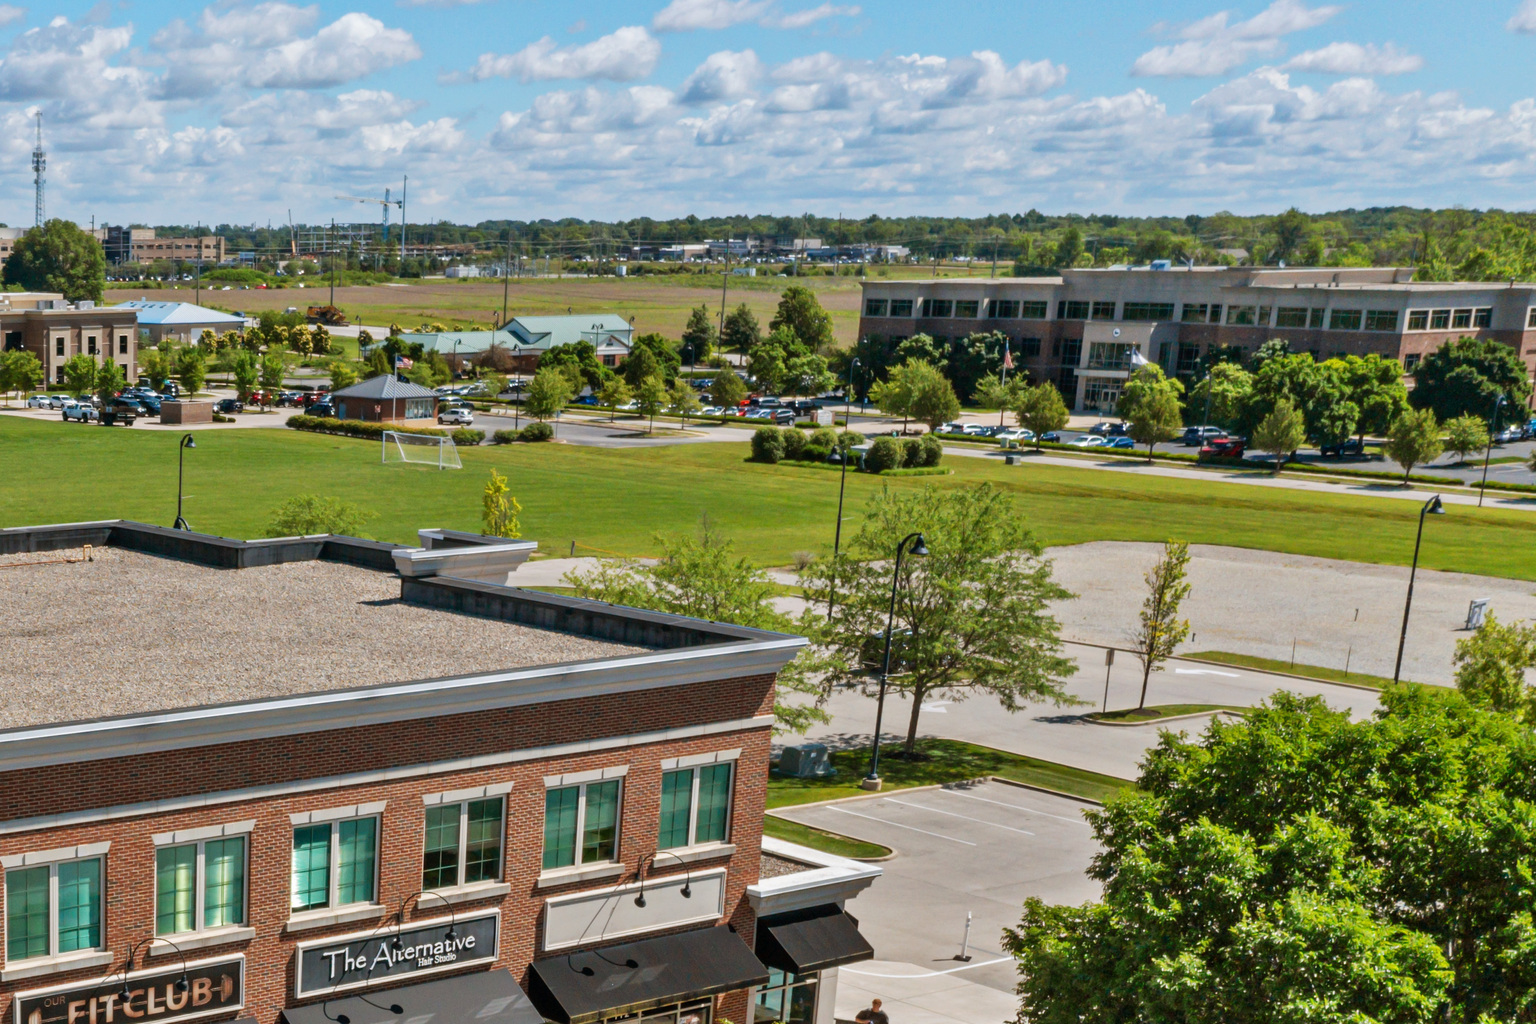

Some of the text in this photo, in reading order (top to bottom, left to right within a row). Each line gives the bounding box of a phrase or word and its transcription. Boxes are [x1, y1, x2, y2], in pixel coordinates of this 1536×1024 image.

[323, 934, 476, 979] The Alternative
[417, 952, 457, 968] Hair Studio
[44, 995, 66, 1008] OUR
